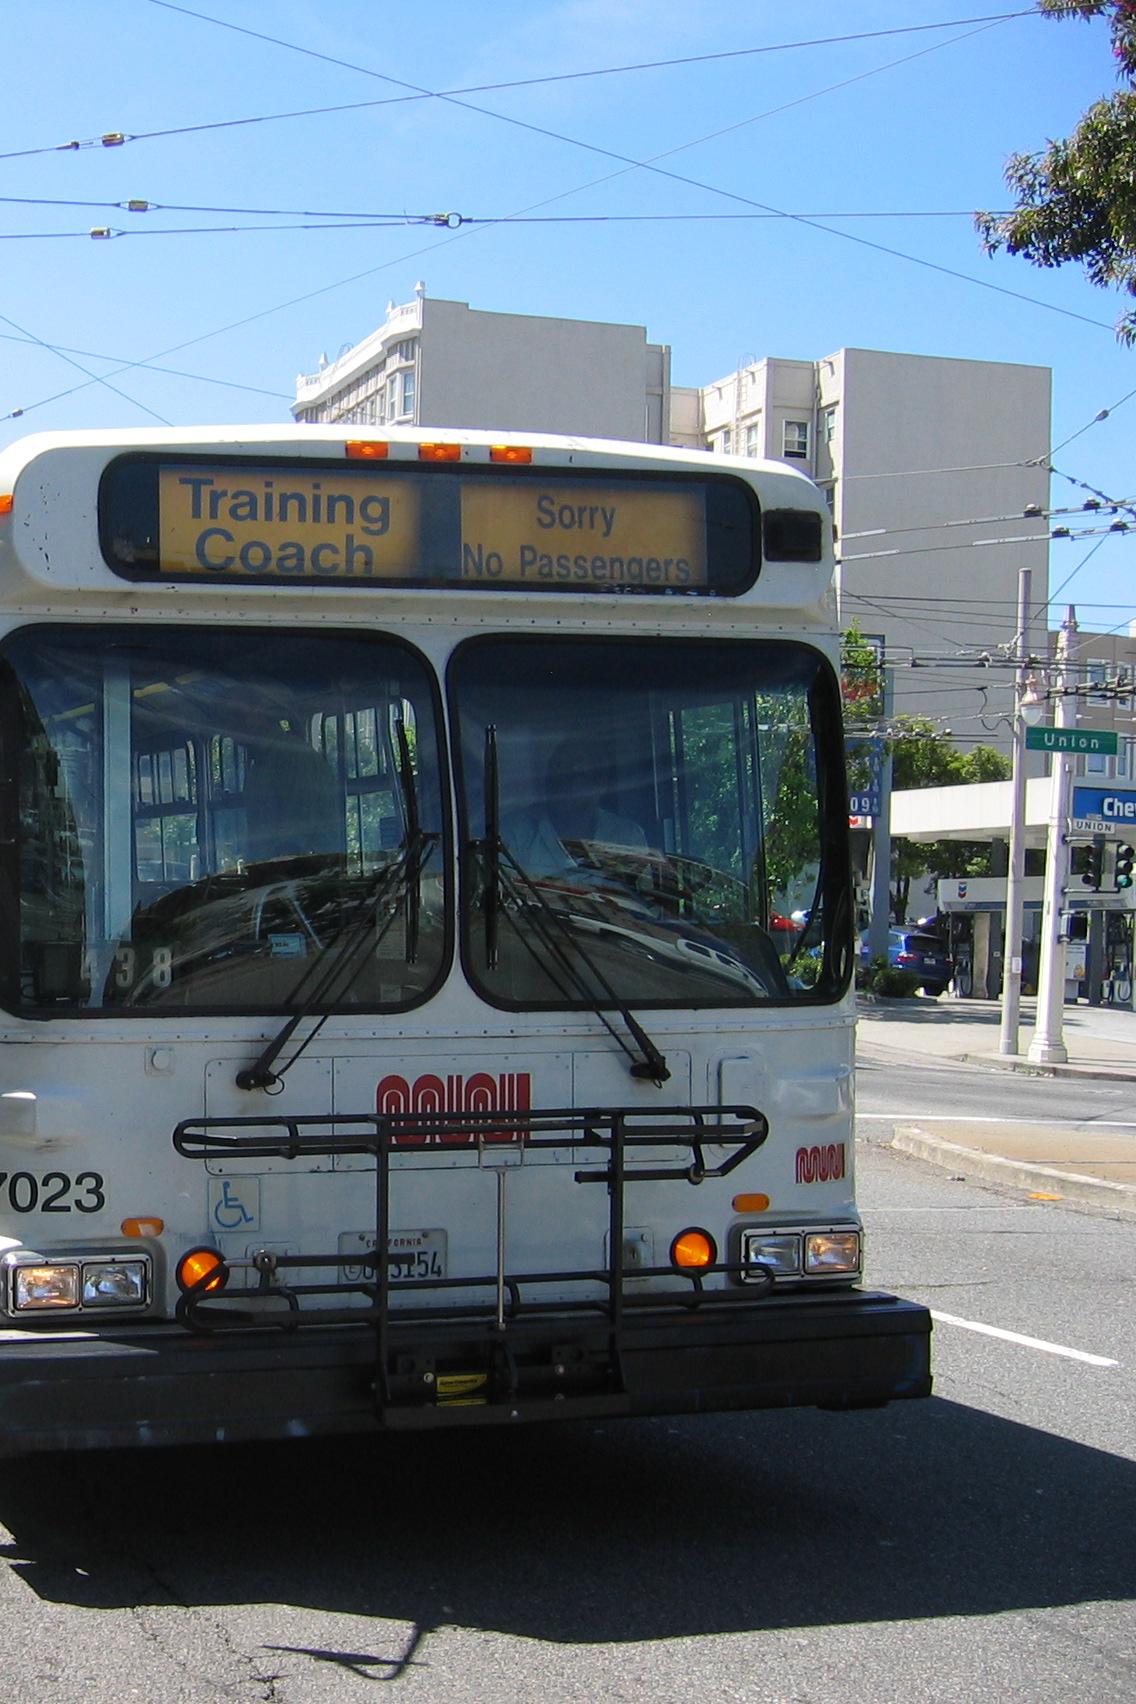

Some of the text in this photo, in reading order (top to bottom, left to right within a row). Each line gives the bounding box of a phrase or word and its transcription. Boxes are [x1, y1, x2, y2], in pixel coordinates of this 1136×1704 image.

[179, 477, 391, 536] Training
[536, 495, 616, 537] Sorry
[195, 527, 373, 575] Coach
[463, 543, 692, 584] No Passengers
[1044, 733, 1099, 749] Union
[1103, 797, 1136, 818] Che
[1076, 821, 1112, 832] UNION
[366, 1238, 423, 1248] CAFORNIA
